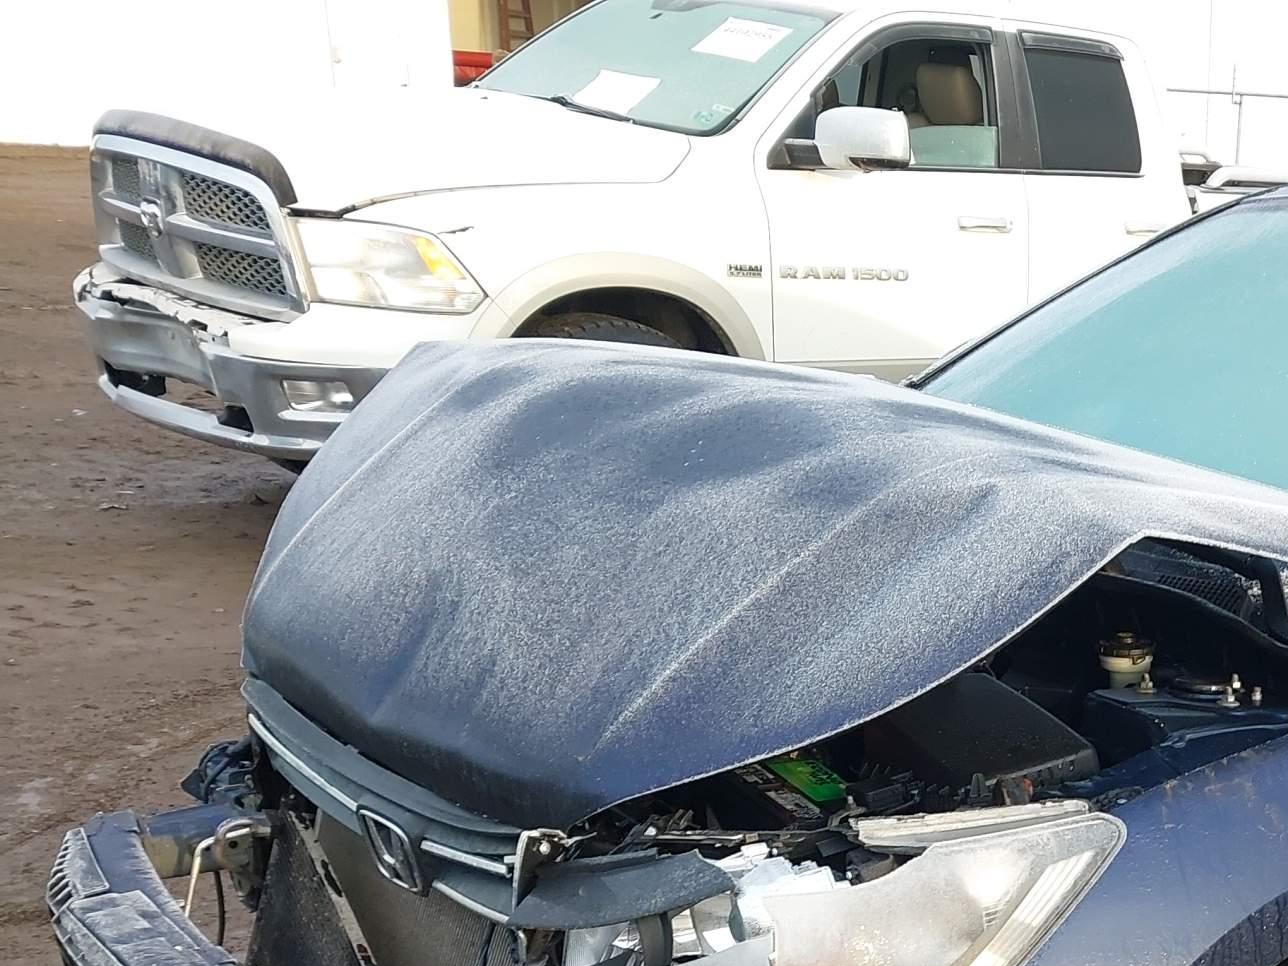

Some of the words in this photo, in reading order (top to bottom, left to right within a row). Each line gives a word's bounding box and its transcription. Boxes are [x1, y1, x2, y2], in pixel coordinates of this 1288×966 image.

[728, 264, 763, 272] HEMI
[779, 265, 846, 280] RAM
[852, 266, 909, 281] 1500
